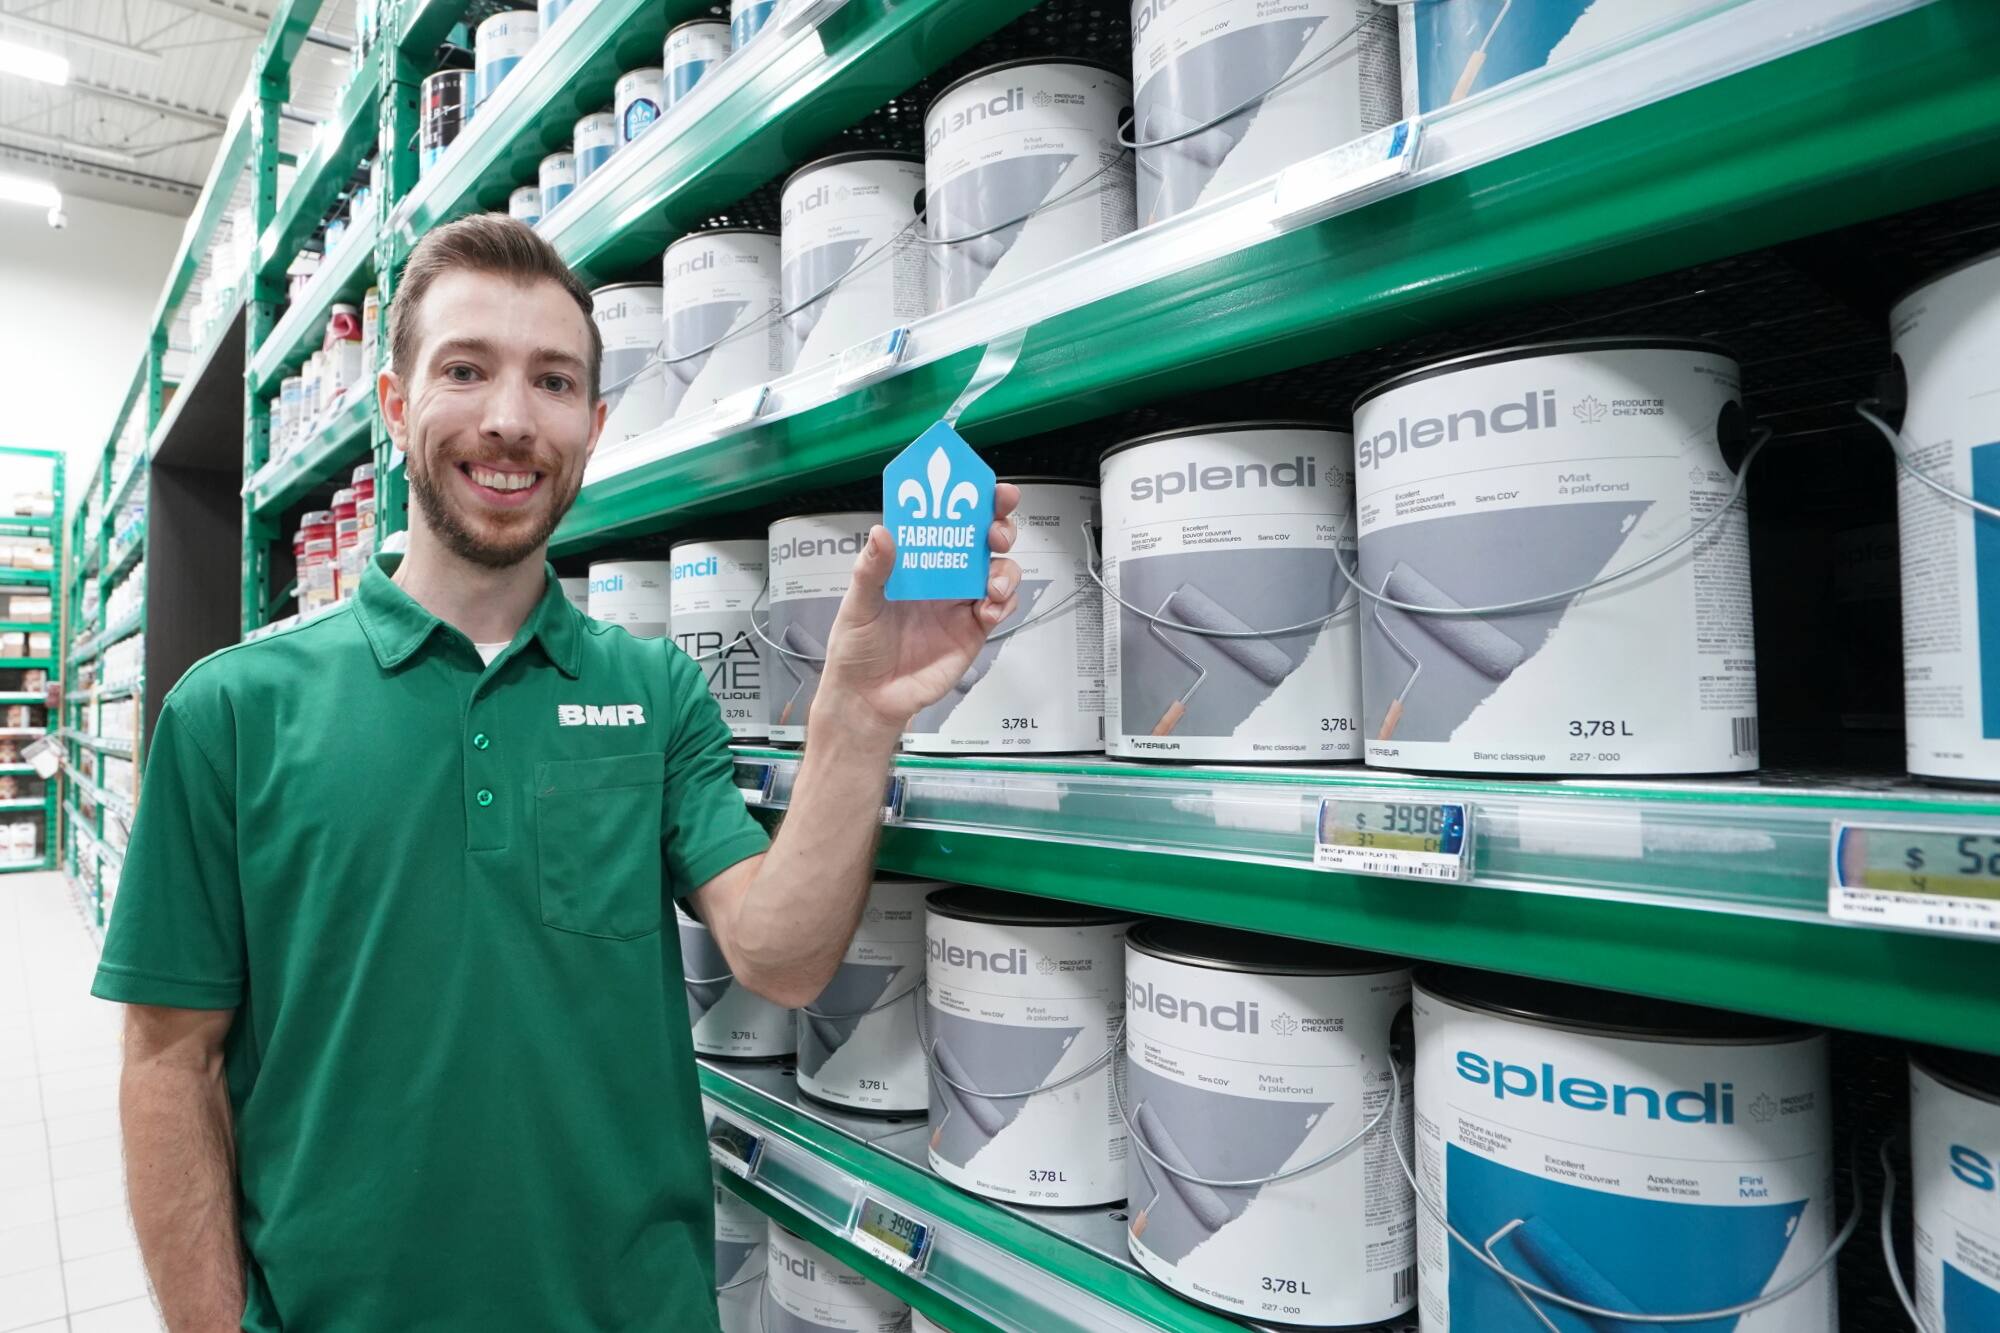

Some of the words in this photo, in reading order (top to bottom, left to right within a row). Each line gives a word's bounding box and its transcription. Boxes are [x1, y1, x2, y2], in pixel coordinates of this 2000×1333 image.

[1612, 400, 1651, 408] PRODUIT
[1653, 399, 1664, 407] DE
[1612, 408, 1637, 416] CHEZ
[1359, 389, 1557, 470] splendi
[1131, 456, 1316, 503] splendi
[1558, 473, 1592, 484] Mat
[1558, 484, 1568, 494] à
[1571, 482, 1630, 495] plafond
[1475, 495, 1496, 503] Sans
[1182, 524, 1209, 532] Excellent
[1316, 524, 1336, 533] Mat
[898, 525, 976, 549] FABRIQUÉ
[902, 552, 918, 568] AU
[920, 550, 968, 570] QUÉBEC
[558, 704, 646, 726] BMR
[1002, 718, 1028, 730] 3,78
[1031, 718, 1038, 729] L
[1321, 718, 1347, 732] 3,78
[1349, 718, 1357, 730] L
[1569, 720, 1615, 739] 3,78
[1621, 720, 1633, 737] L
[1275, 744, 1307, 752] classique
[1473, 751, 1498, 761] Blanc
[1500, 752, 1546, 762] classique
[1569, 752, 1590, 761] 227
[1599, 752, 1621, 761] 000
[1905, 846, 1925, 871] $
[1034, 1014, 1069, 1022] plafond
[731, 1031, 750, 1040] 3,78
[859, 1080, 881, 1090] 3,78
[882, 1081, 888, 1090] L
[1258, 1074, 1284, 1084] Mat
[1268, 1085, 1314, 1096] plafond
[1456, 1051, 1734, 1125] splendi
[1458, 1118, 1484, 1133] Peinture
[1485, 1129, 1494, 1137] au
[1494, 1129, 1512, 1143] latex
[1477, 1134, 1508, 1150] acrylique
[1545, 1155, 1585, 1170] Excellent
[1029, 1169, 1056, 1183] 3,78
[1059, 1171, 1067, 1182] L
[1545, 1165, 1577, 1178] pouvoir
[1579, 1171, 1620, 1187] couvrant
[1647, 1174, 1699, 1187] Application
[1739, 1176, 1763, 1185] Fini
[1647, 1186, 1670, 1194] sans
[1671, 1187, 1700, 1196] tracas
[1739, 1188, 1768, 1198] Mat
[1261, 1277, 1297, 1294] 3,78
[1301, 1281, 1311, 1295] L
[1192, 1282, 1210, 1296] Blanc
[1211, 1289, 1245, 1306] classique
[1261, 1302, 1278, 1312] 227
[1282, 1305, 1300, 1314] 000
